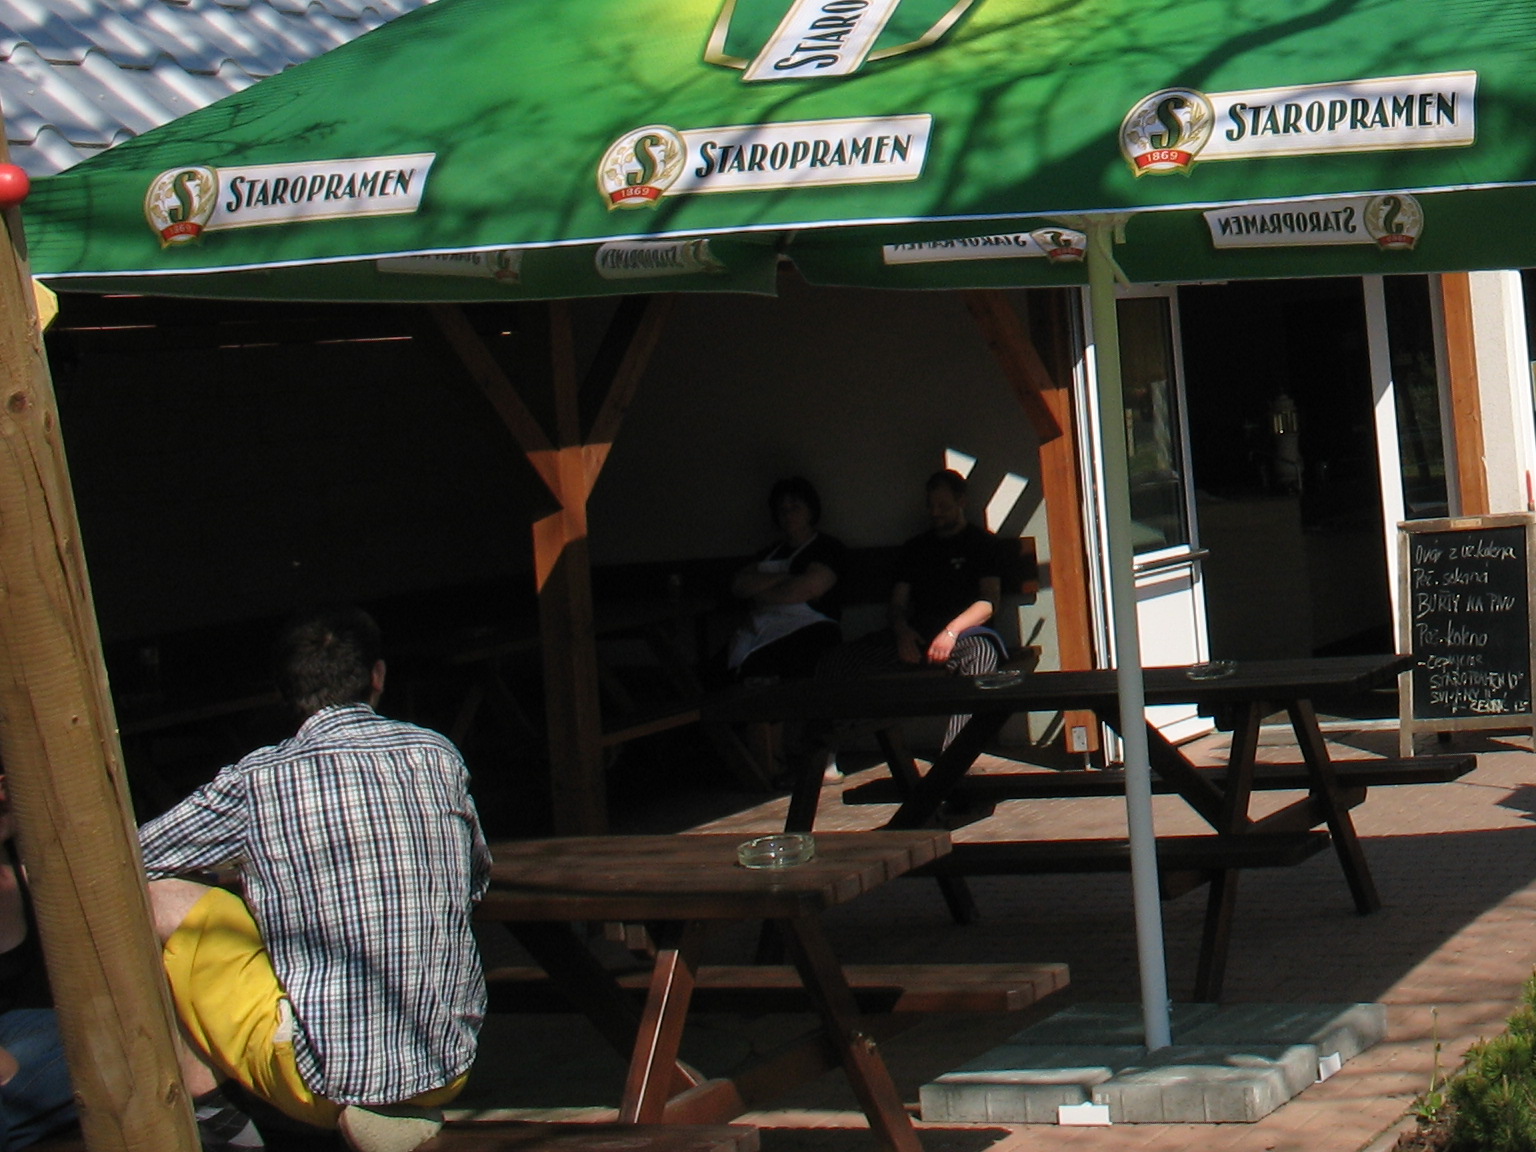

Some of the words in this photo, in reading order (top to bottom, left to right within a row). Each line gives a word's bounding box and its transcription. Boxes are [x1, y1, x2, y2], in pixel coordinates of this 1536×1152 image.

[1151, 97, 1186, 148] S
[1225, 91, 1457, 142] STAROPRAMEN
[626, 135, 661, 186] S
[695, 134, 914, 179] STAROPRAMEN
[1146, 149, 1179, 162] 1869
[169, 170, 195, 222] S
[226, 168, 416, 213] STAROPRAMEN
[620, 185, 650, 198] 1869
